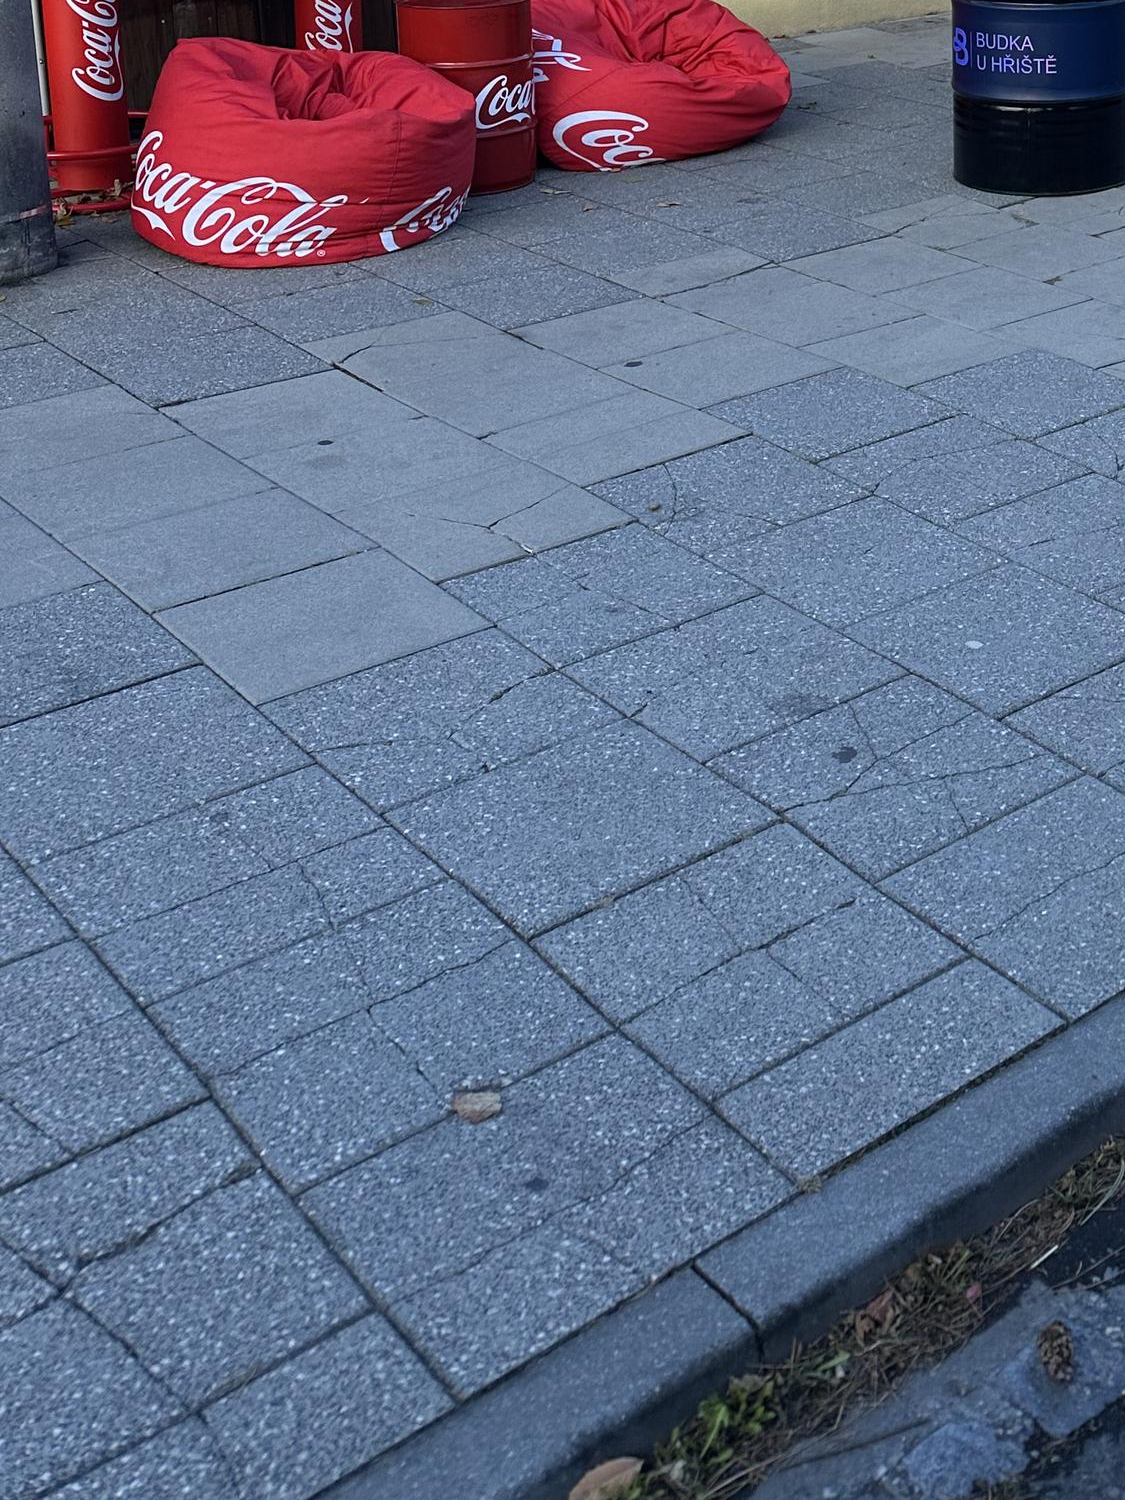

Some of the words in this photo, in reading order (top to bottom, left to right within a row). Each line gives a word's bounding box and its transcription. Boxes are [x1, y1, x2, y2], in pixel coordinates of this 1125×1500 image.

[976, 32, 1034, 51] BUDKA
[977, 54, 987, 71] U
[991, 53, 1057, 74] HŘIŠTĚ
